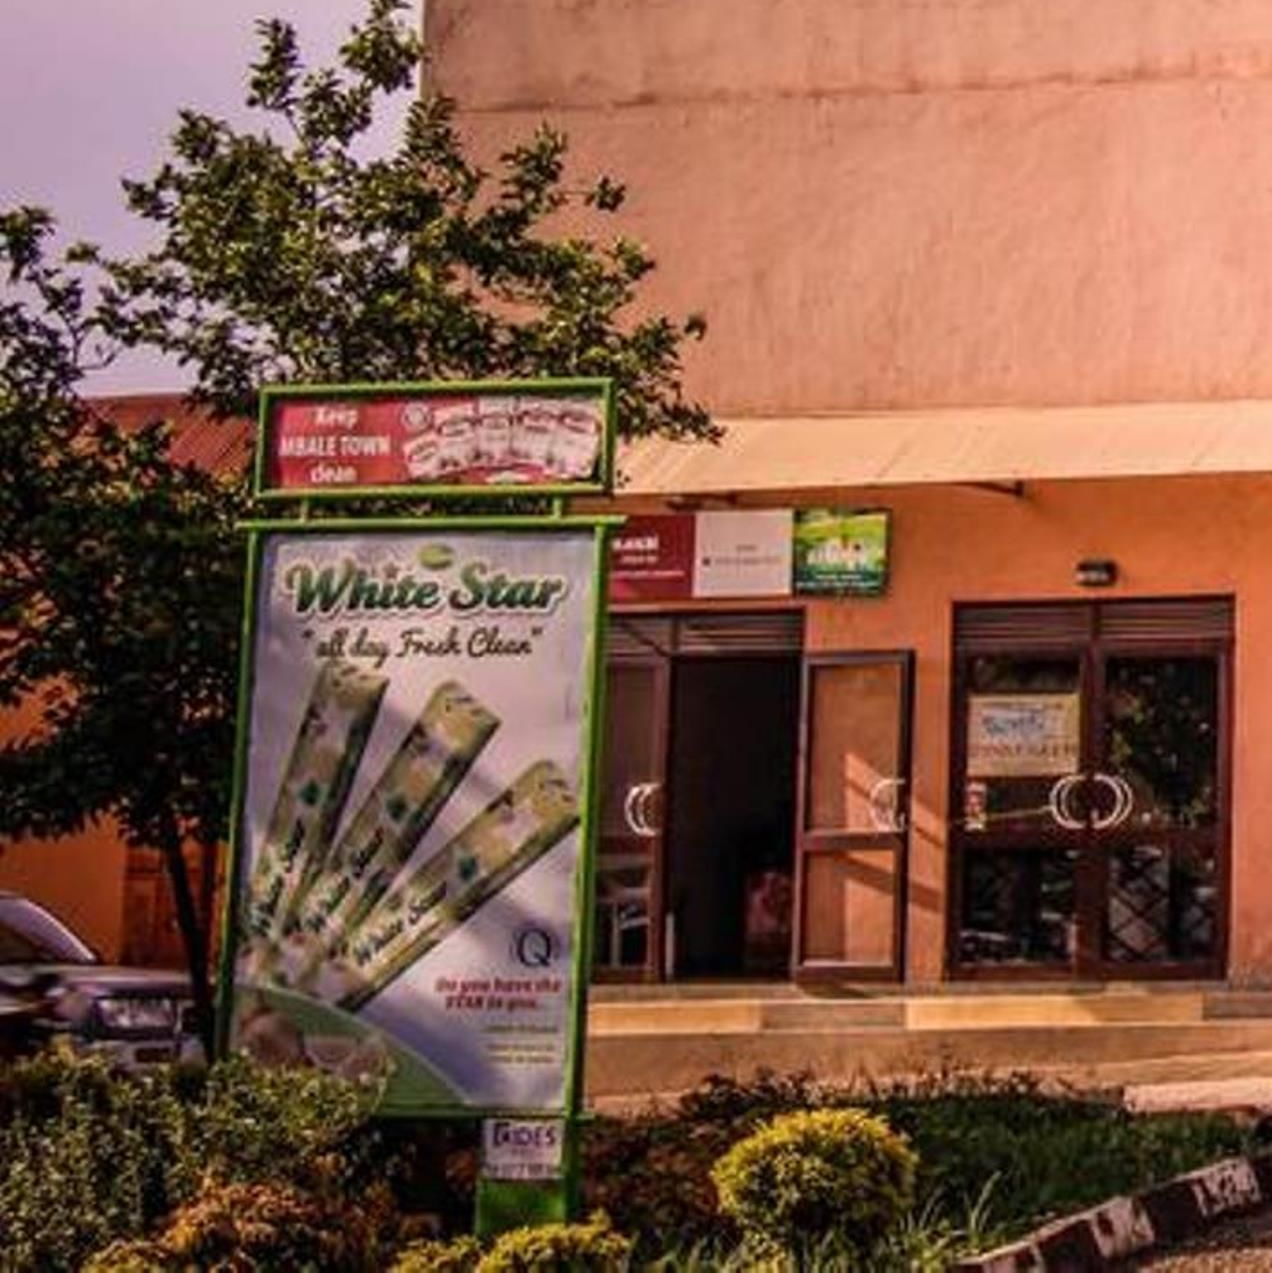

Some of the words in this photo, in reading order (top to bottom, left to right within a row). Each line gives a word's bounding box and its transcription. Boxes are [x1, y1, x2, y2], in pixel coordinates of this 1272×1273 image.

[311, 405, 359, 428] Keep
[280, 435, 337, 457] MBALE
[341, 434, 391, 456] TOWN
[309, 462, 358, 483] clean
[284, 557, 441, 614] White
[449, 562, 566, 611] Star
[395, 630, 460, 658] Fresh
[494, 976, 533, 992] have
